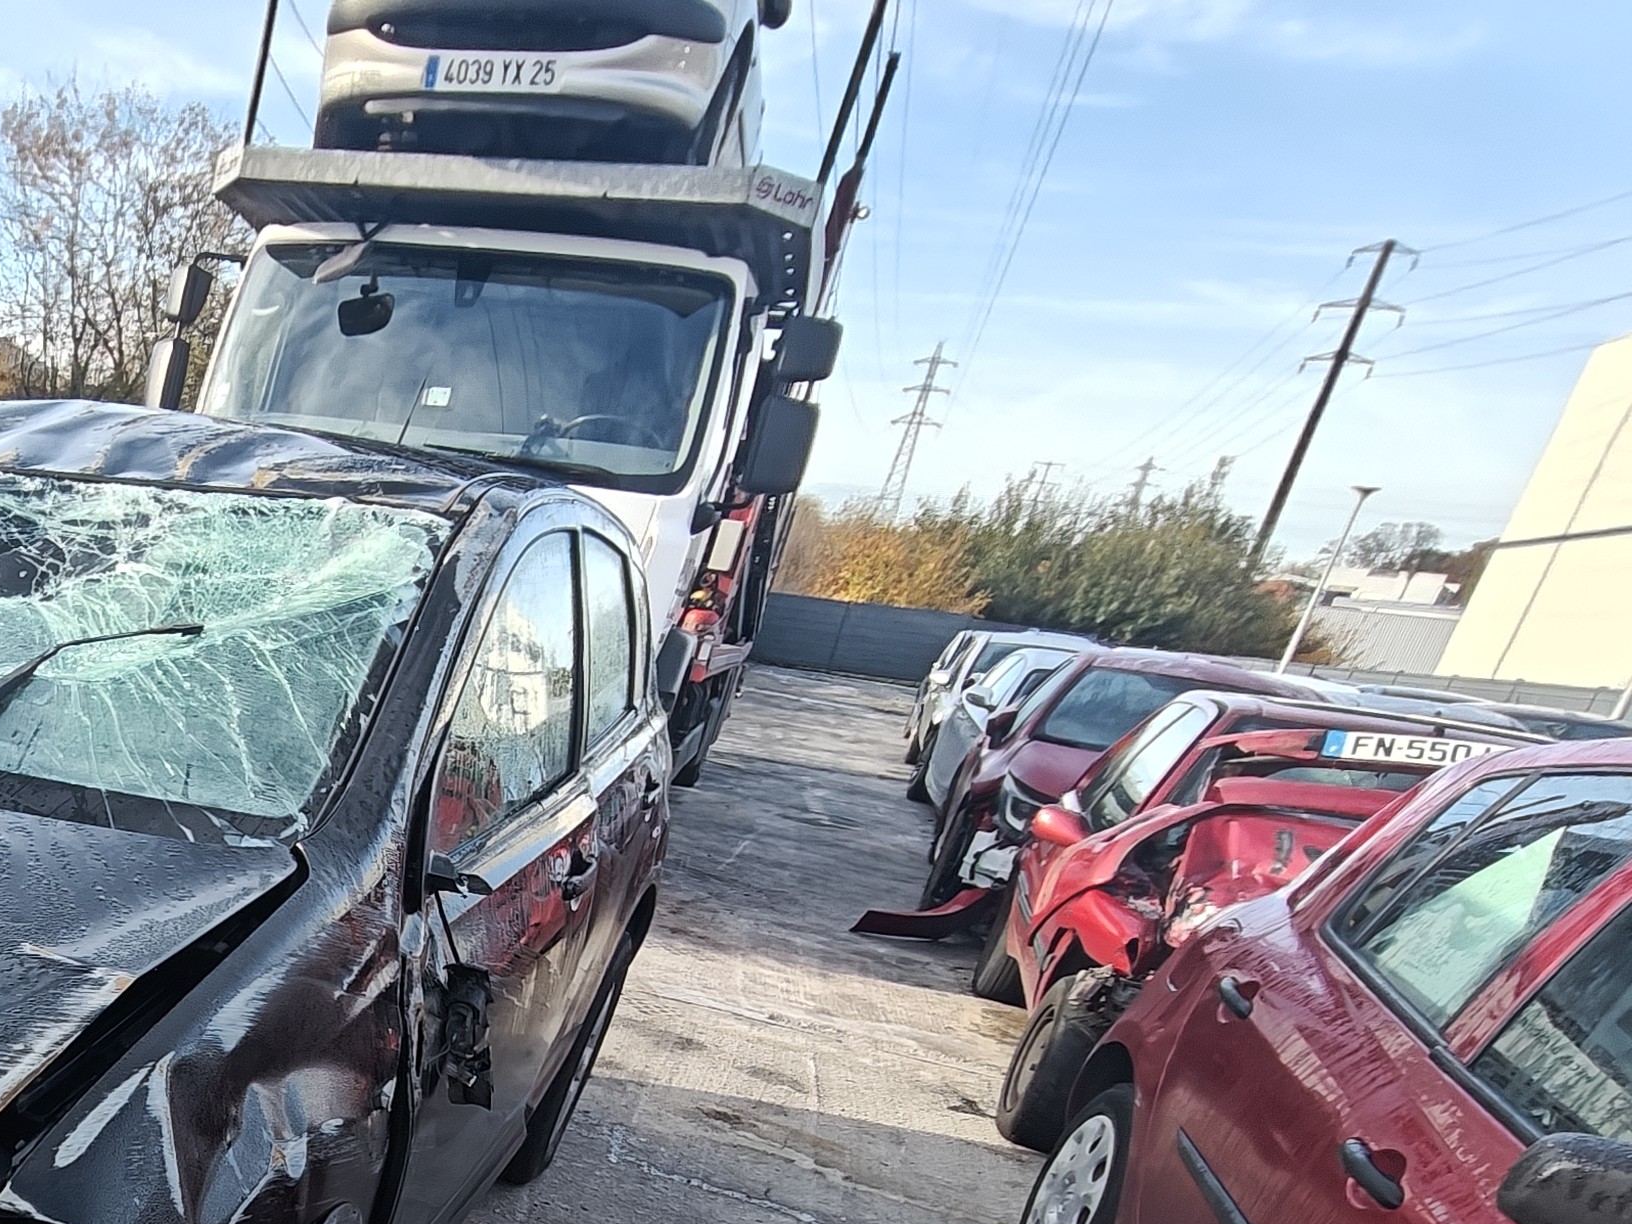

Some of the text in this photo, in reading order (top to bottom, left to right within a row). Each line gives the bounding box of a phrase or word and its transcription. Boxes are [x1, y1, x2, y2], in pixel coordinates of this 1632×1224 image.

[443, 58, 557, 86] 4039 YX 25
[773, 182, 814, 210] Lohr
[1350, 735, 1491, 763] FN-550
